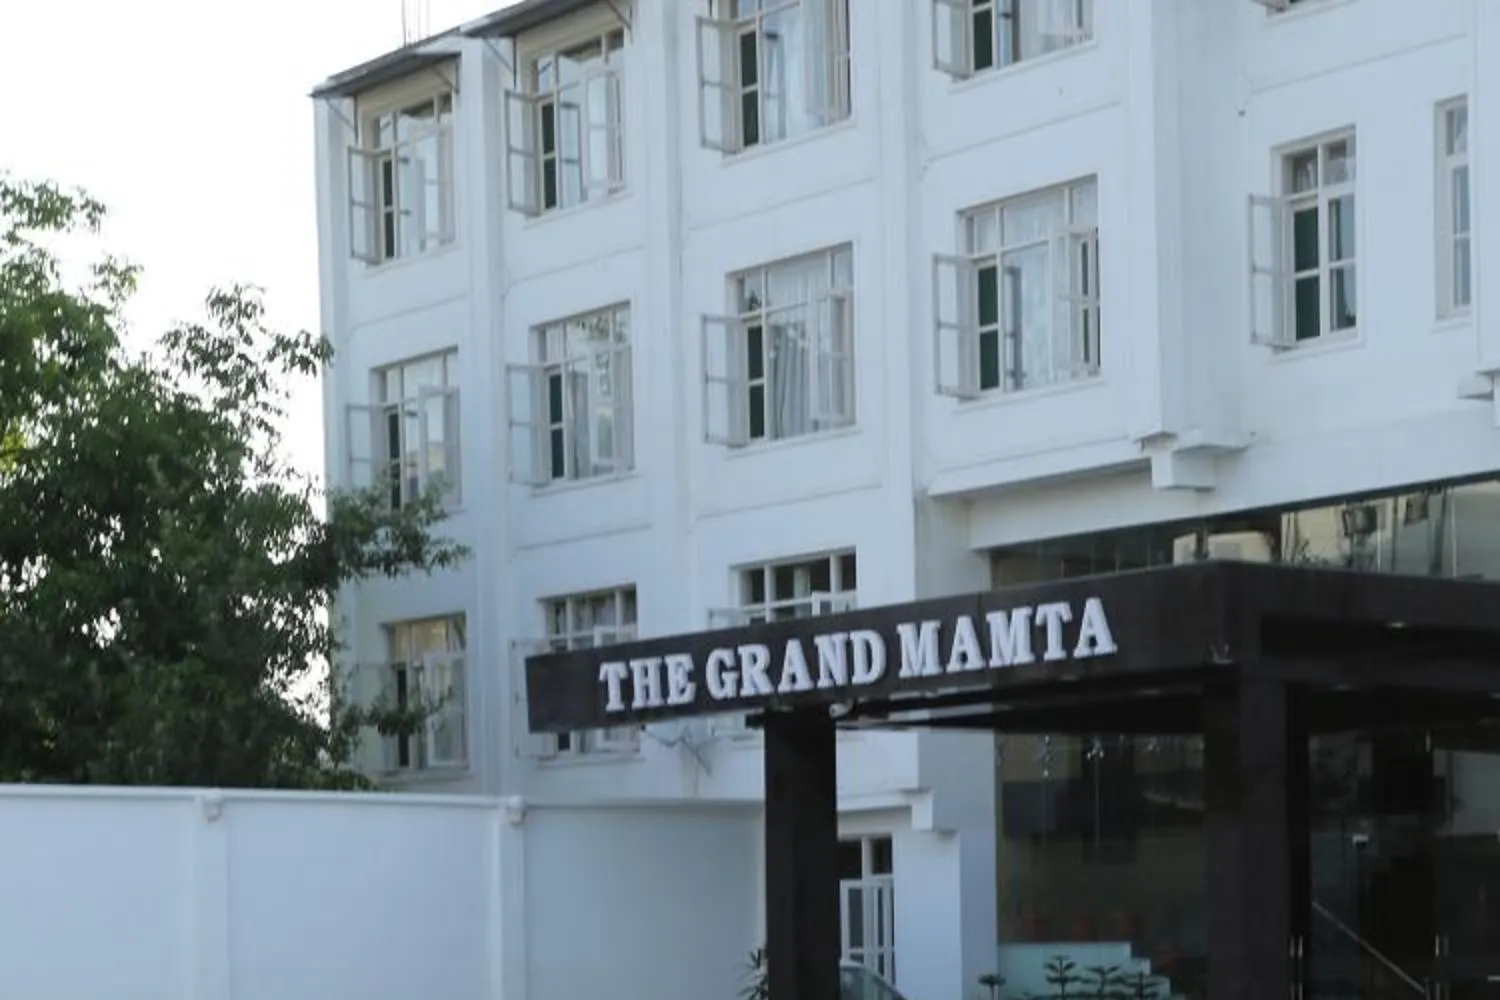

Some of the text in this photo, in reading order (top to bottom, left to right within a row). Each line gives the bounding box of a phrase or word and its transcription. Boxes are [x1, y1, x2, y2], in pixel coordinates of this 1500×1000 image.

[599, 597, 1118, 712] THE GRAND MAMTA
